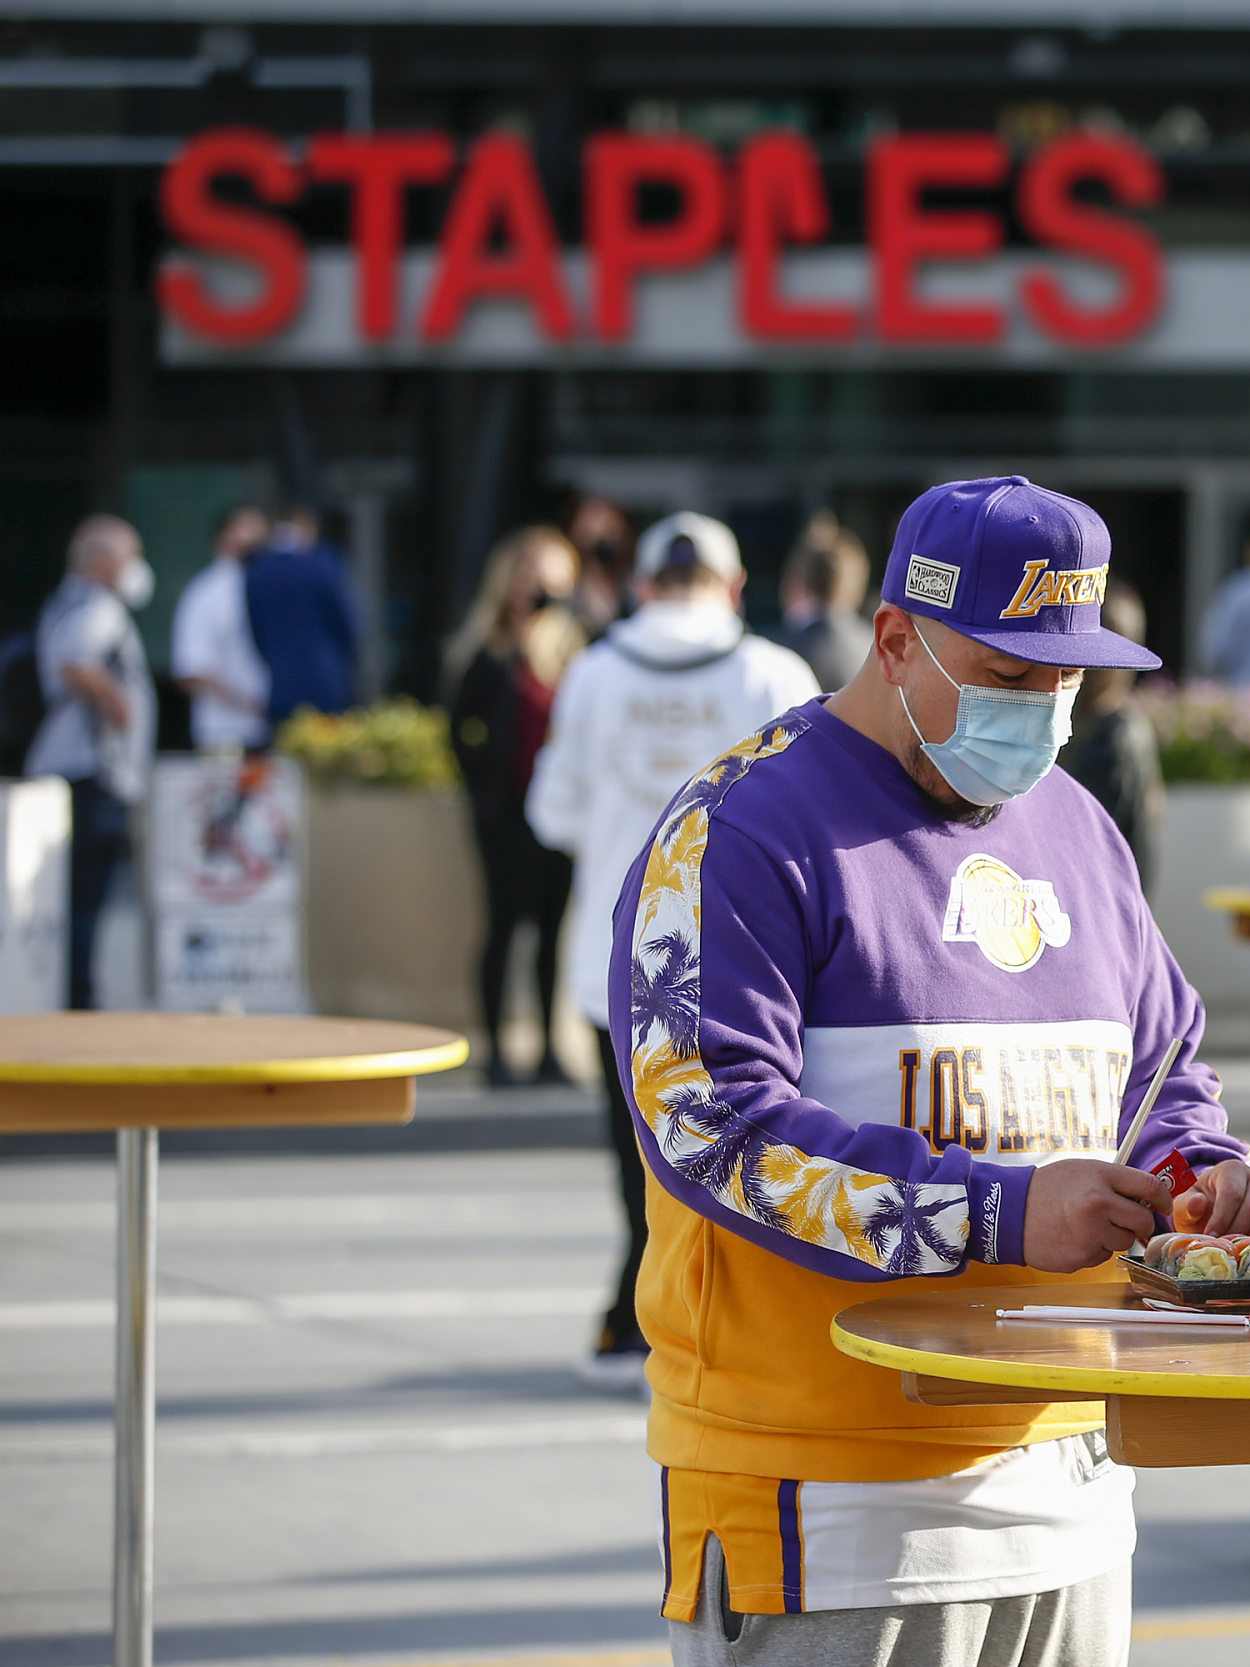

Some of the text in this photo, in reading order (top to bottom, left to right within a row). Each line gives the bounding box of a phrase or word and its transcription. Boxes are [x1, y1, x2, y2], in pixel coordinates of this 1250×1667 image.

[157, 128, 1167, 350] STAPLES
[917, 581, 948, 598] CLASSICS
[920, 567, 950, 587] HARDWOOD
[899, 1045, 989, 1155] LOS
[981, 1182, 1001, 1264] Mitchell & Ness
